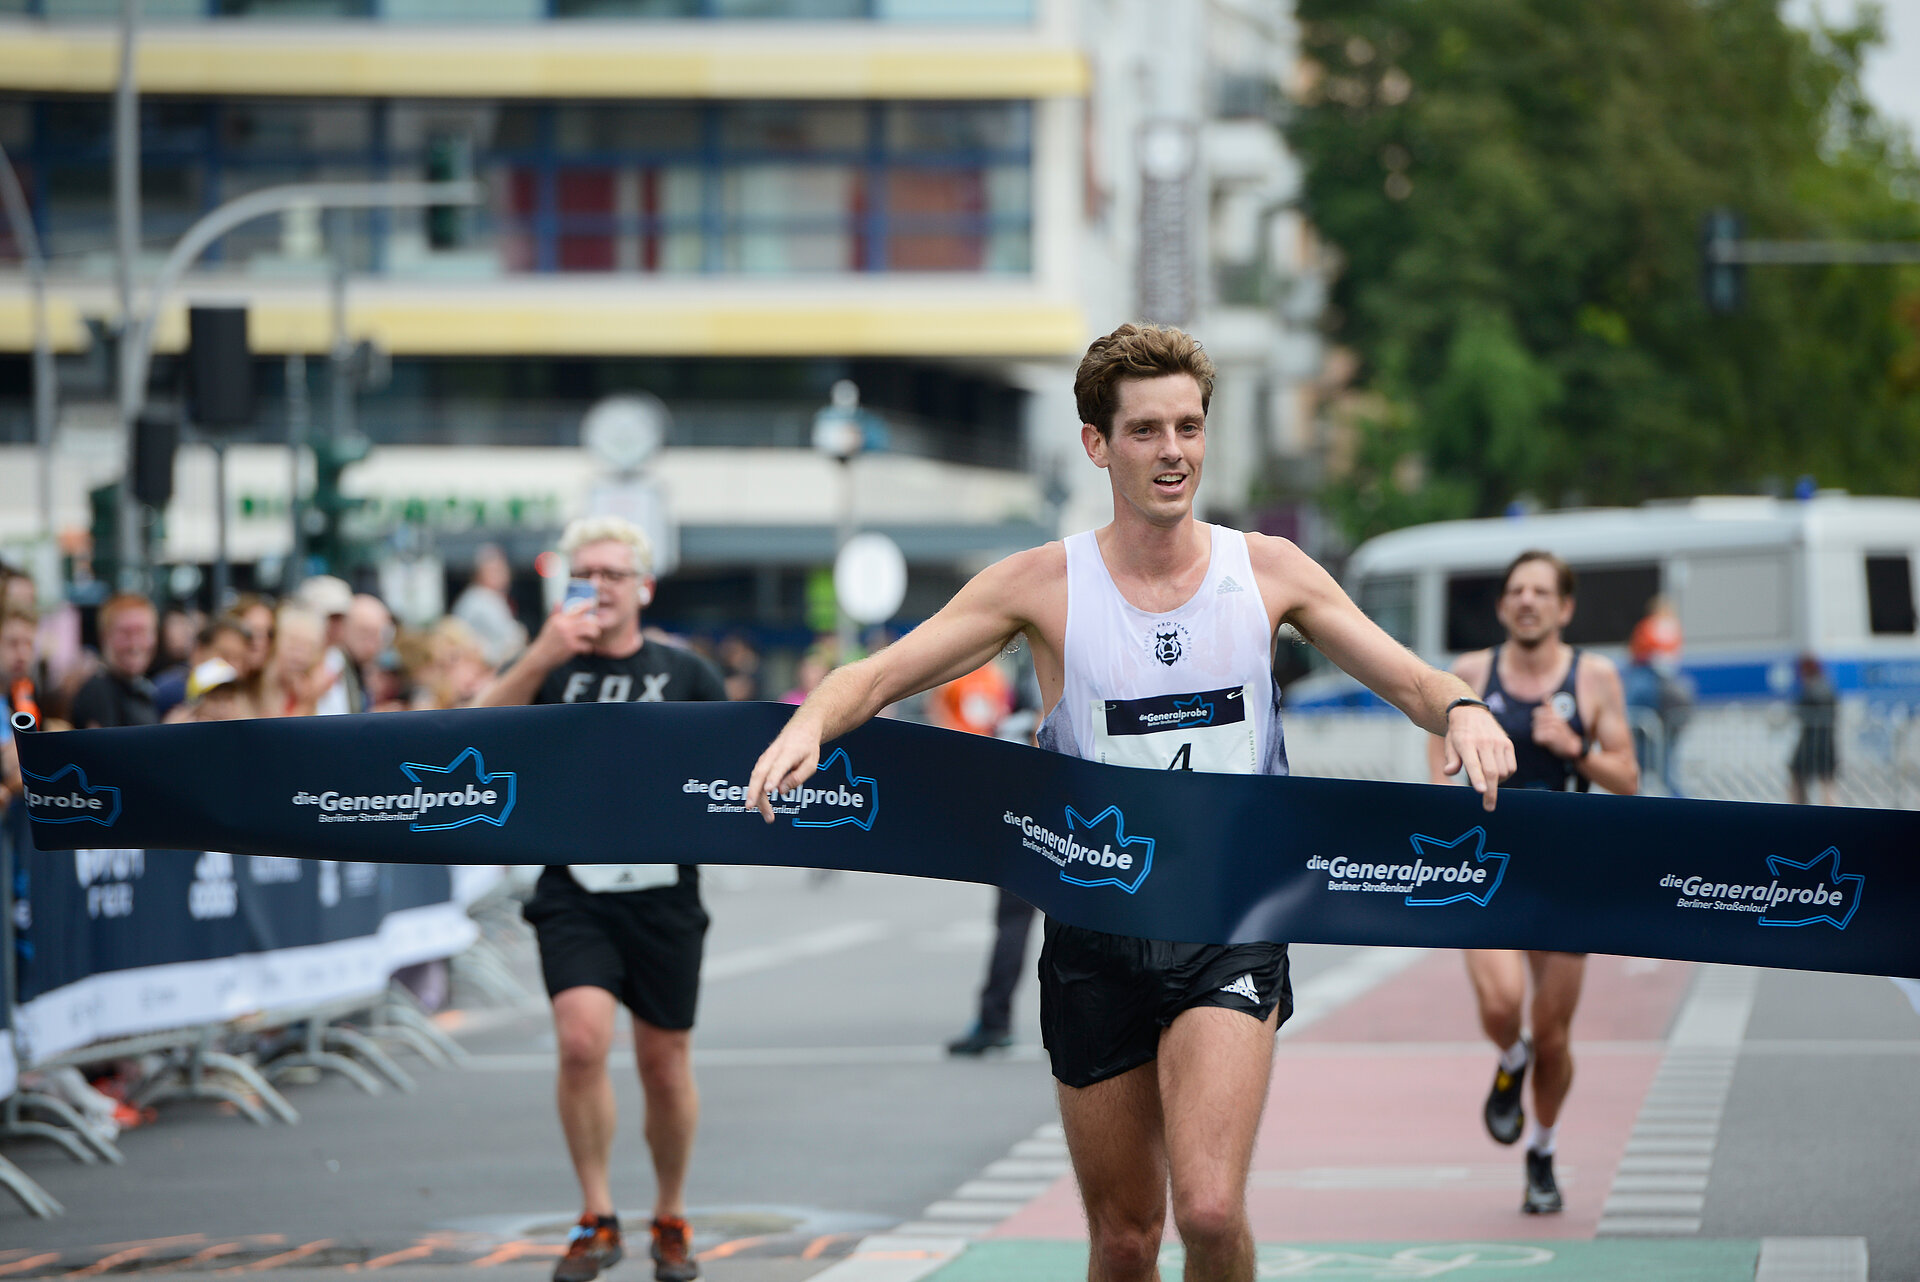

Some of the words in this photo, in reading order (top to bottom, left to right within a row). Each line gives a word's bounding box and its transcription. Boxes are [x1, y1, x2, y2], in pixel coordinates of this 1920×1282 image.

[563, 672, 670, 702] FOX
[1168, 743, 1193, 771] 4
[1328, 881, 1362, 892] Berliner
[1362, 881, 1414, 893] Straßenlauf
[1677, 898, 1713, 909] Berliner
[1713, 901, 1768, 913] Straßenlauf
